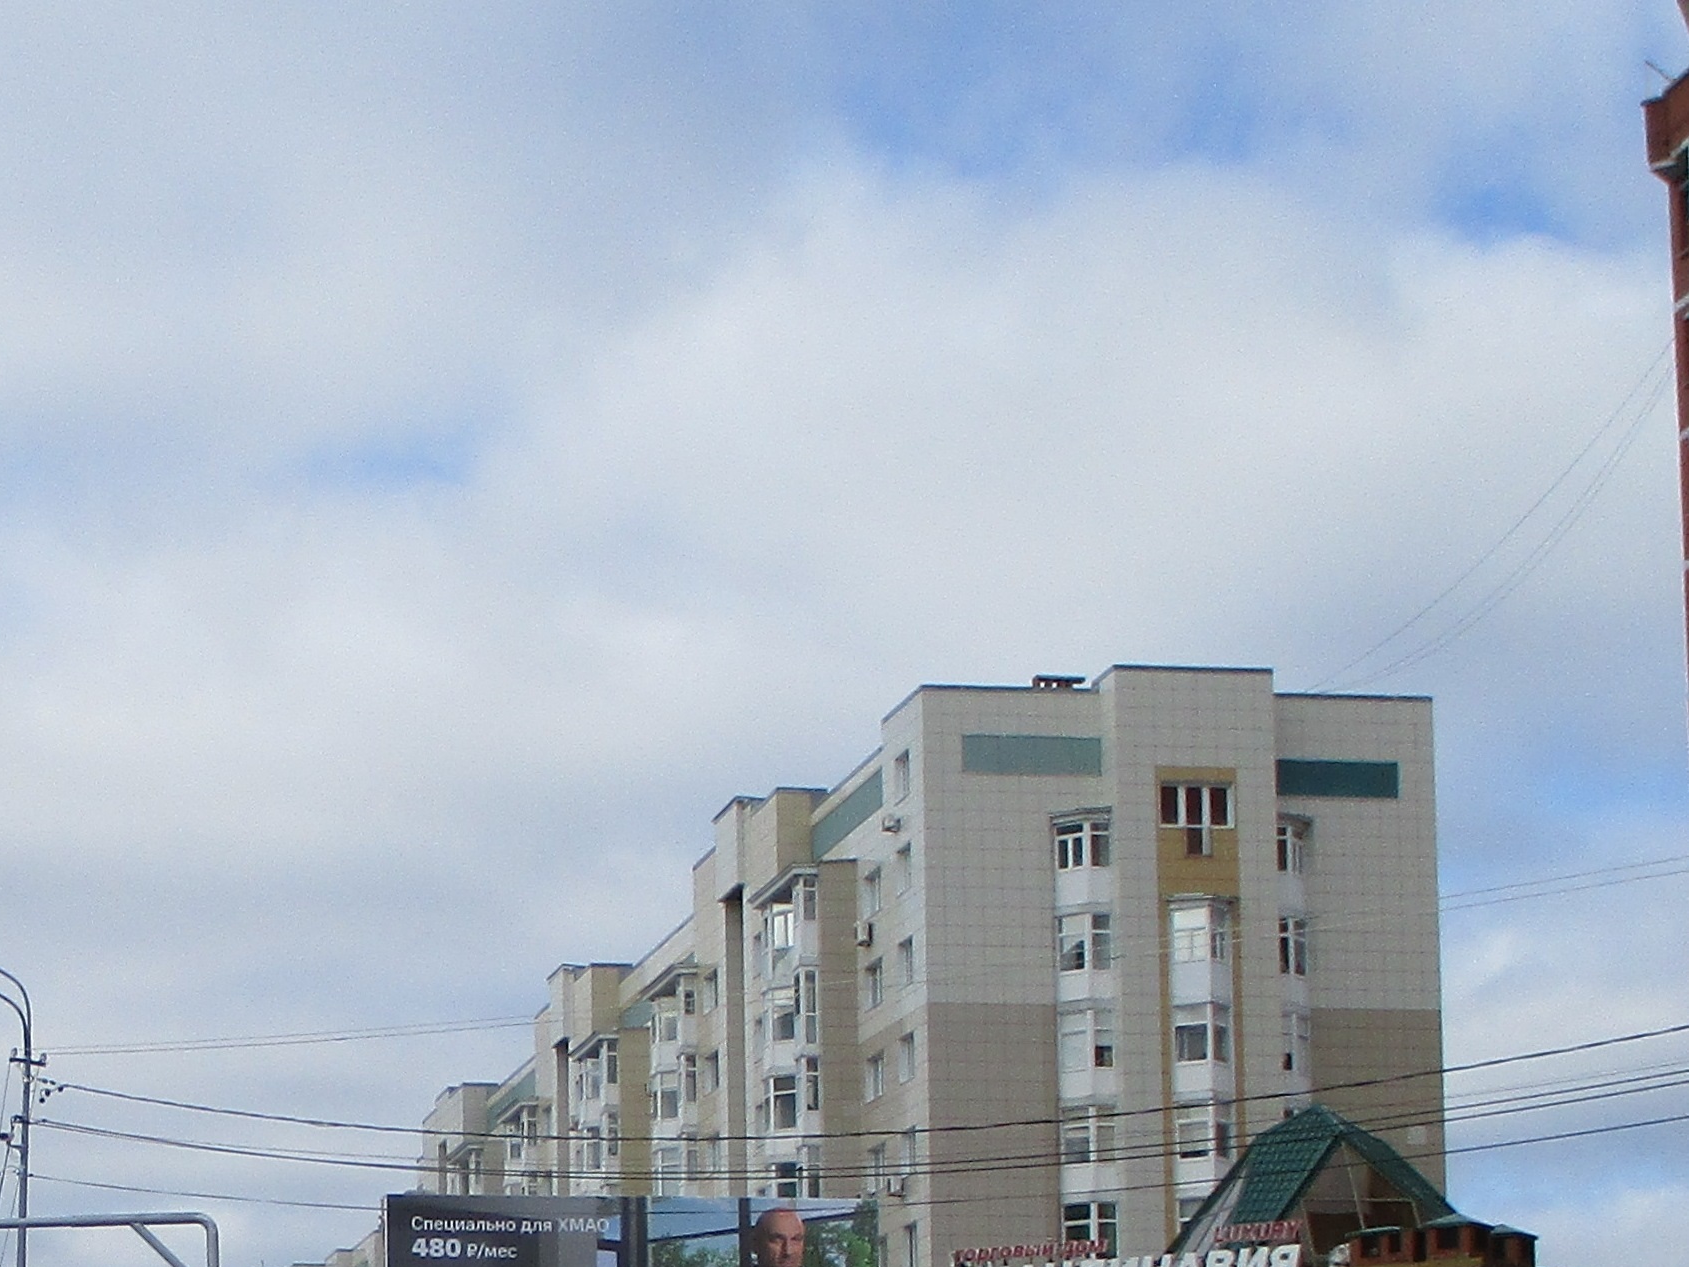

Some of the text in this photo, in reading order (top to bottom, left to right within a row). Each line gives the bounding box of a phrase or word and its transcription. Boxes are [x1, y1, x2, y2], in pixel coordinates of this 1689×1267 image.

[411, 1215, 610, 1234] Специально для ХМАО
[411, 1237, 462, 1258] 480
